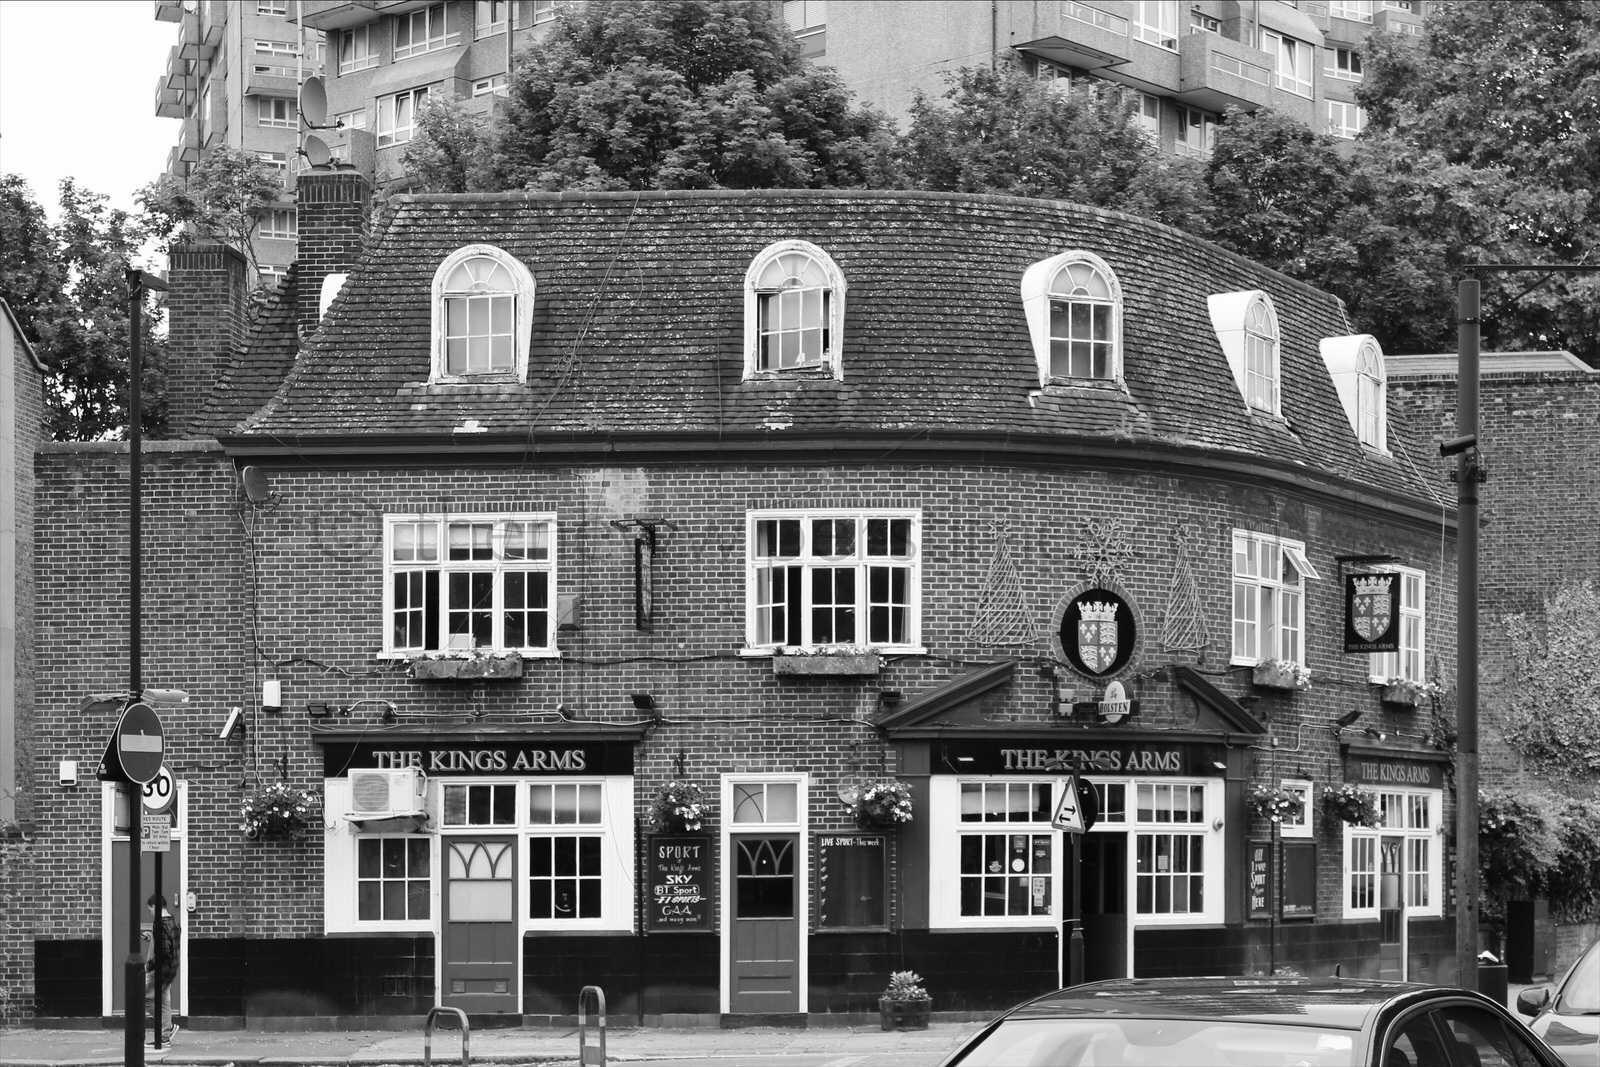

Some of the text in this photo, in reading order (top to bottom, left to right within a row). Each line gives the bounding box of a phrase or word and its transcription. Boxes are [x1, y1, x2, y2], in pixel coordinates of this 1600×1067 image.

[1099, 702, 1128, 713] HOLSTEN
[372, 750, 586, 771] THE KINGS ARMS
[1001, 749, 1048, 770] THE
[1126, 751, 1181, 771] ARMS
[1361, 762, 1430, 784] THE KINGS ARMS
[821, 837, 834, 847] LIVE
[659, 846, 701, 858] SPORT
[666, 875, 692, 884] SKY
[656, 885, 698, 896] BT Sport
